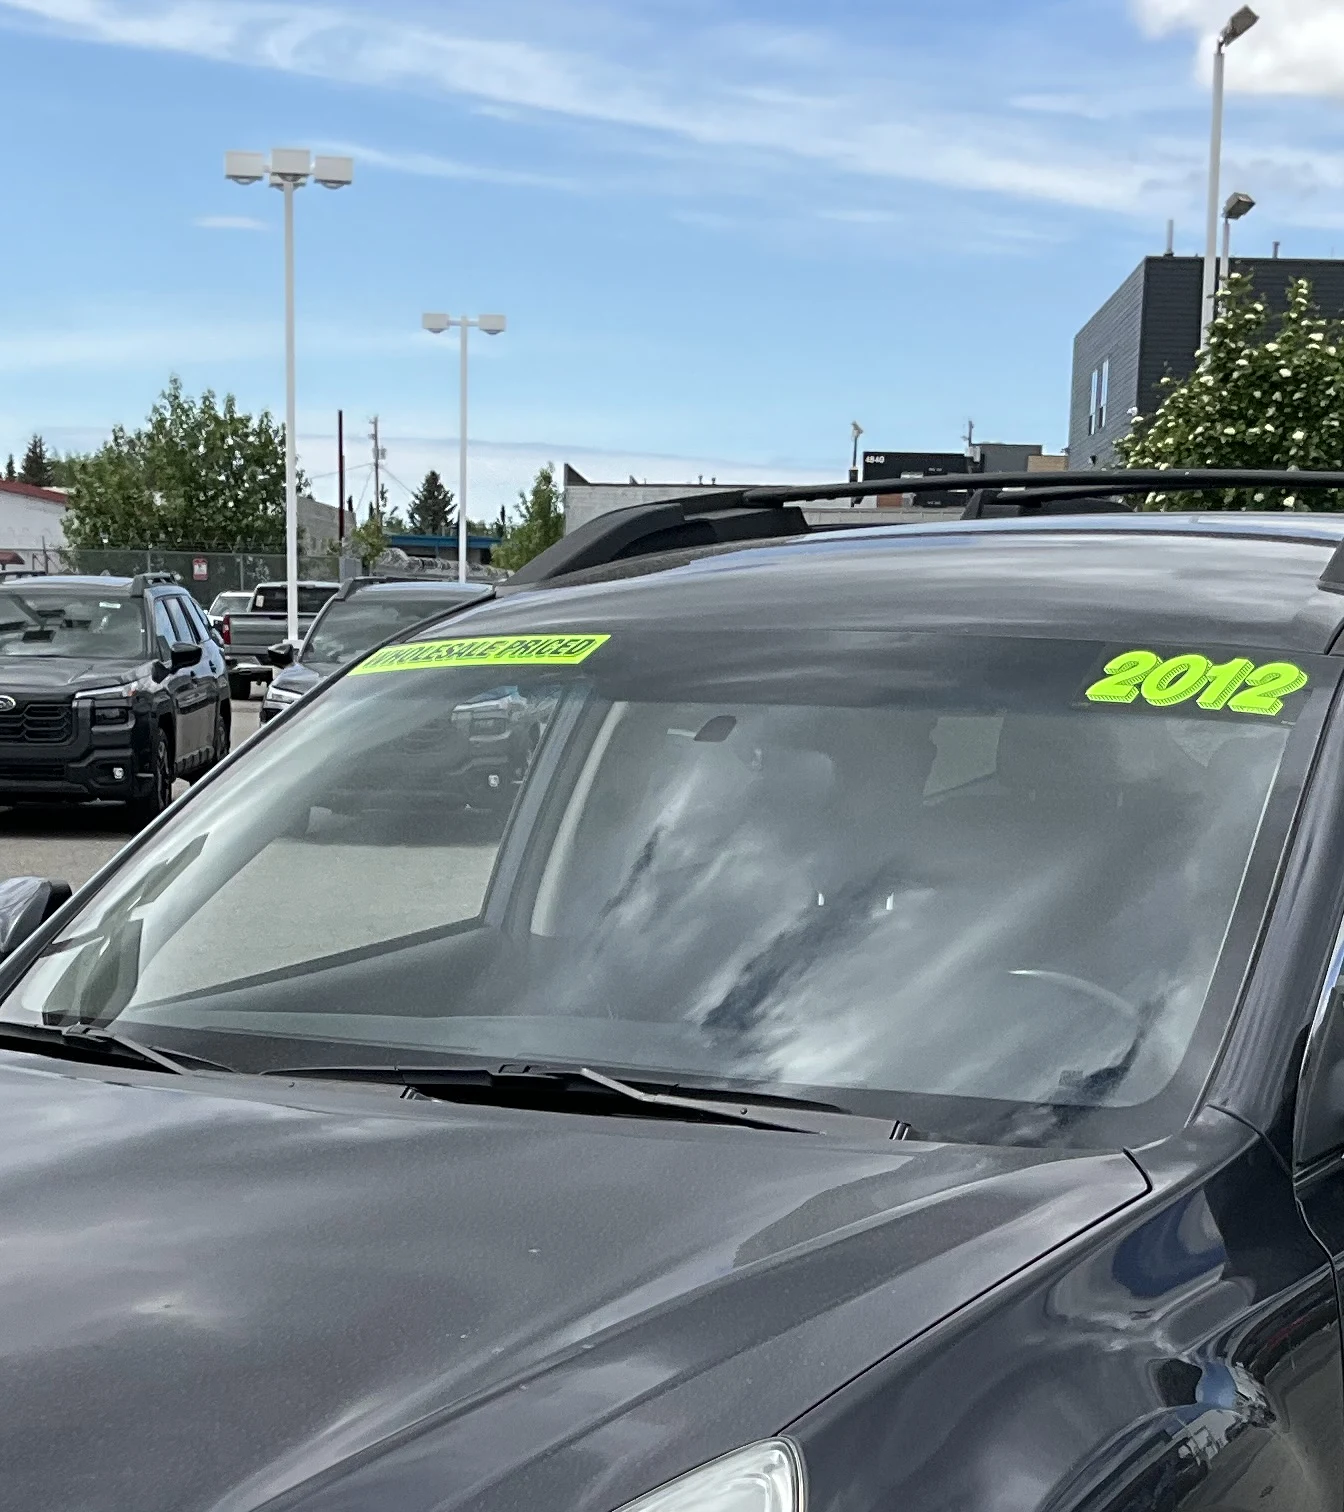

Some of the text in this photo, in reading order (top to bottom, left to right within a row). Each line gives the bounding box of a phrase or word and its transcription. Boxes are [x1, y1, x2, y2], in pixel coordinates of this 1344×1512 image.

[361, 639, 597, 669] WHOLESALE PRICED
[1085, 650, 1308, 716] 2012
